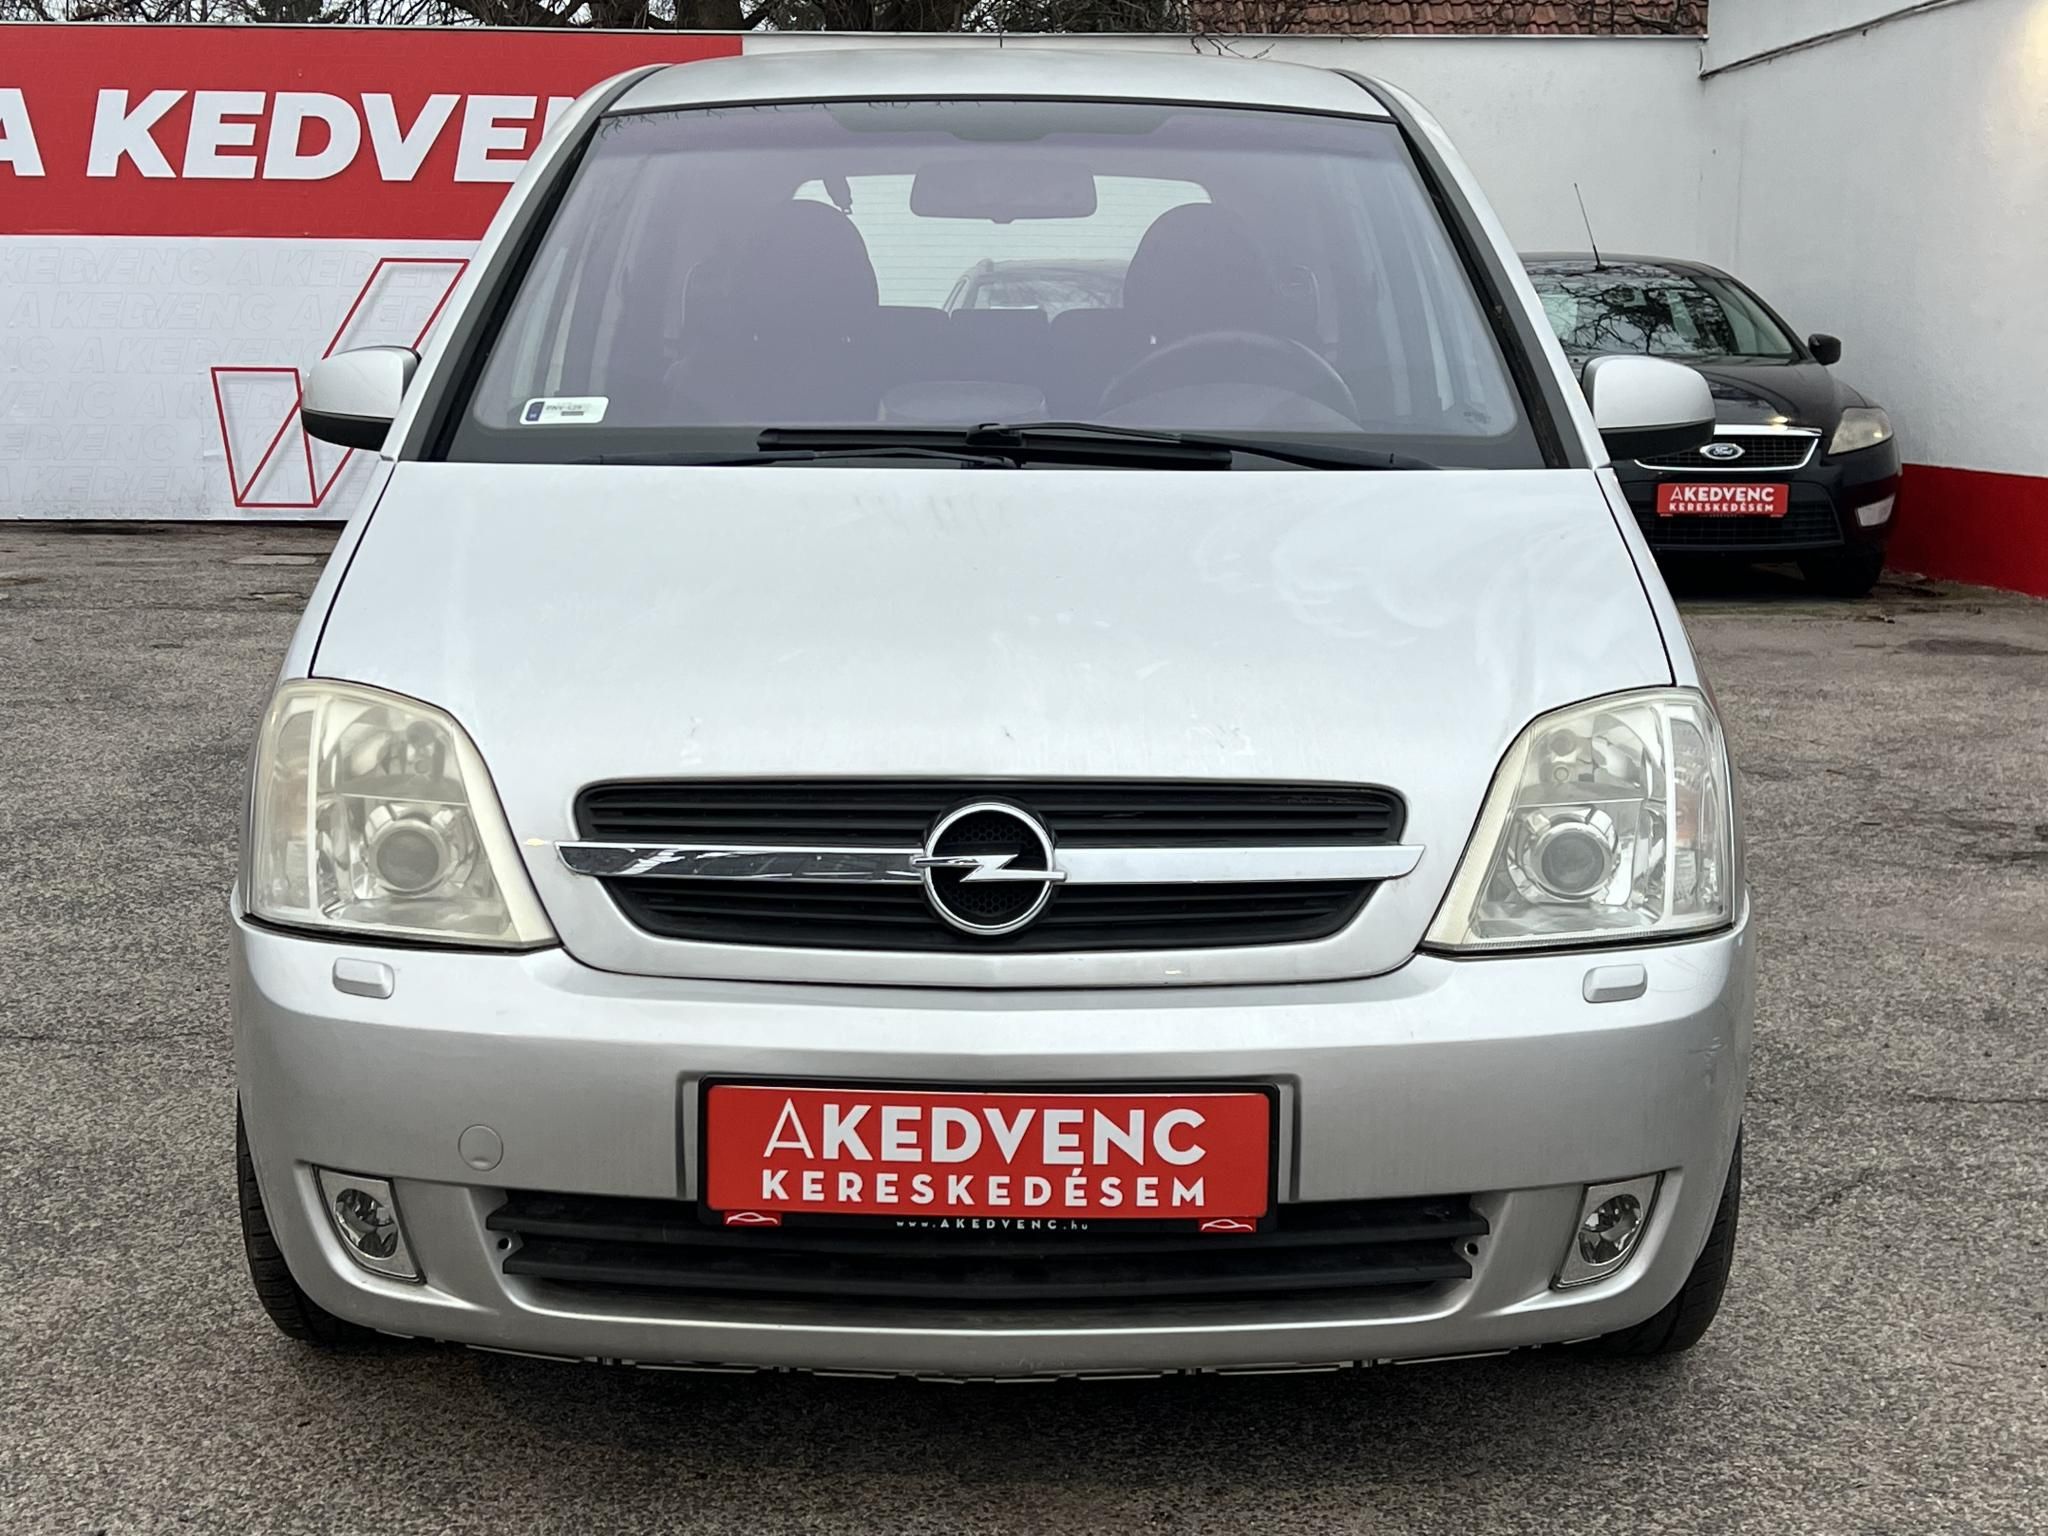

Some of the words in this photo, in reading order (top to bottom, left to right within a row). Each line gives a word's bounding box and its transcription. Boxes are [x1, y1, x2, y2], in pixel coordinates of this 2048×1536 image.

[1670, 486, 1775, 502] AKEDVENC
[1669, 502, 1774, 512] KERESKEDÉSEM
[763, 1097, 1207, 1166] AKEDVENC
[762, 1167, 1206, 1208] KERESKEDÉSEM
[896, 1218, 1089, 1231] www.AKEDVENC.hu
